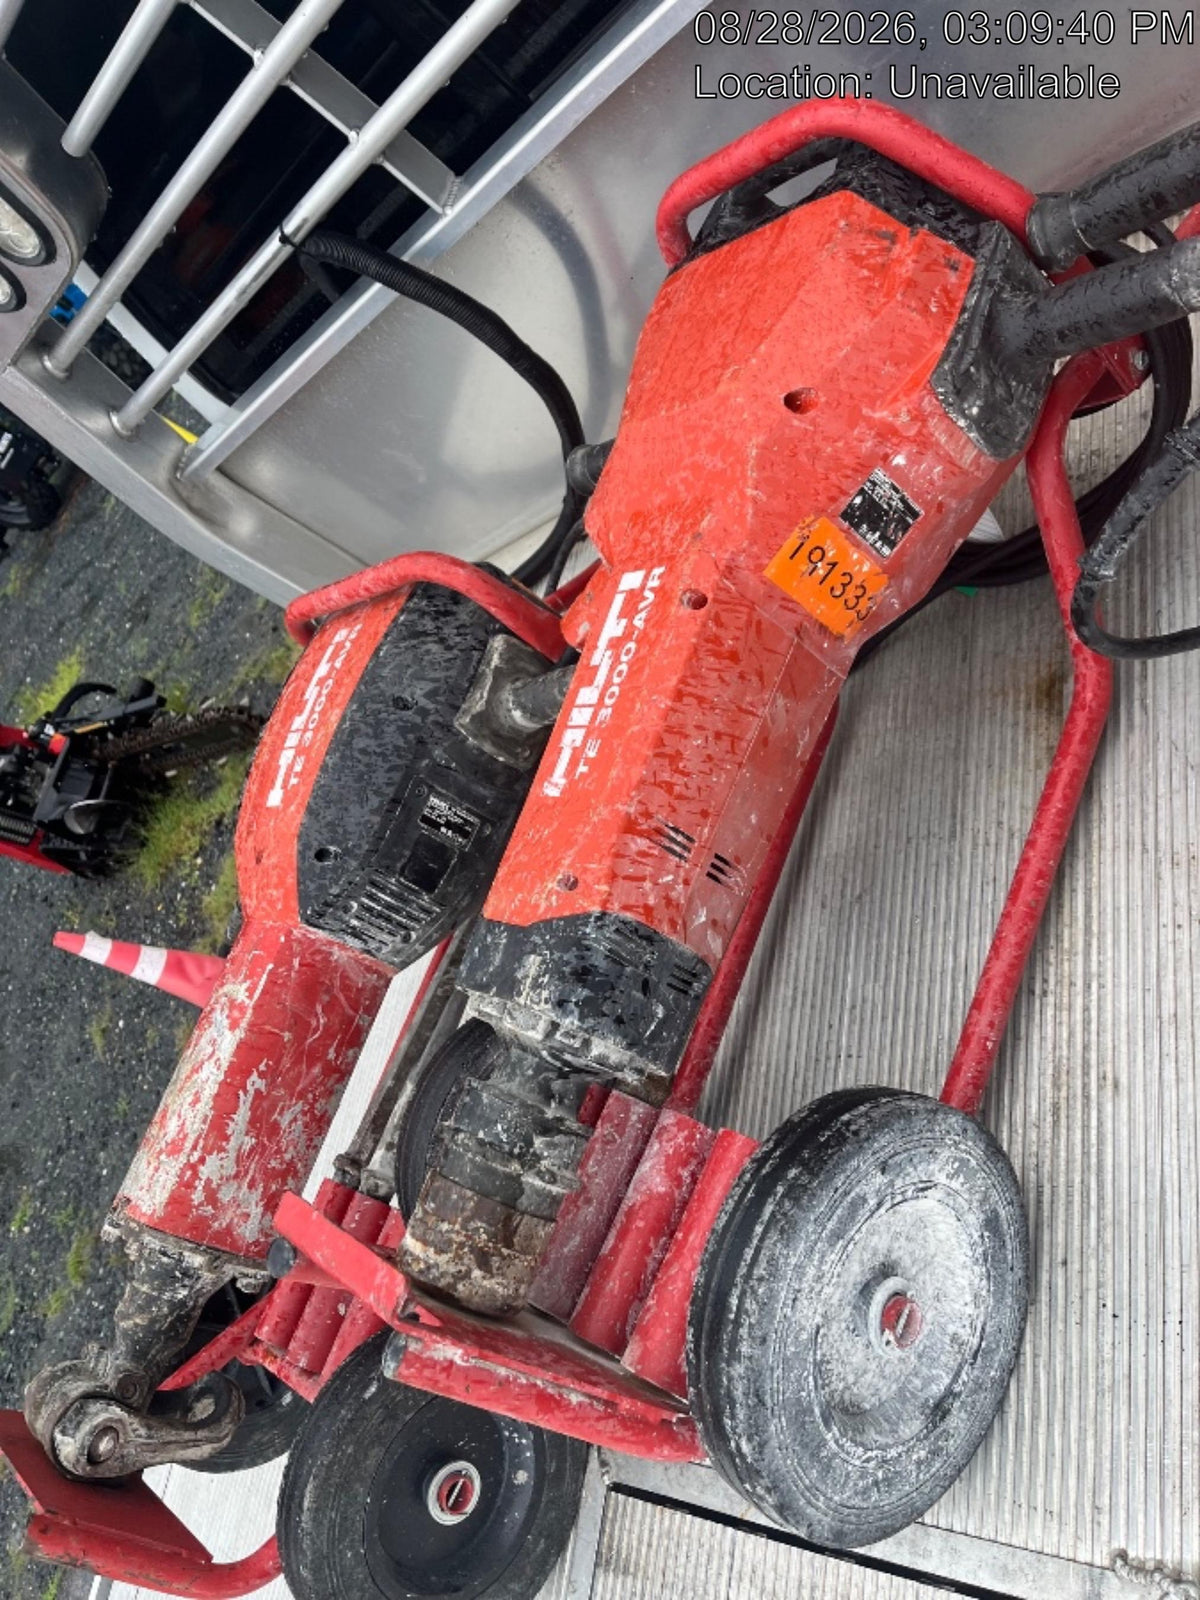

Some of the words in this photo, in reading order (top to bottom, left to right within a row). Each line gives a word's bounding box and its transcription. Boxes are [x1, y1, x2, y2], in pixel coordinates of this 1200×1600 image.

[266, 628, 349, 808] HILTI
[541, 569, 646, 797] HILTI
[574, 738, 602, 780] TE
[595, 565, 667, 728] 3000-AVR
[287, 755, 306, 790] TE
